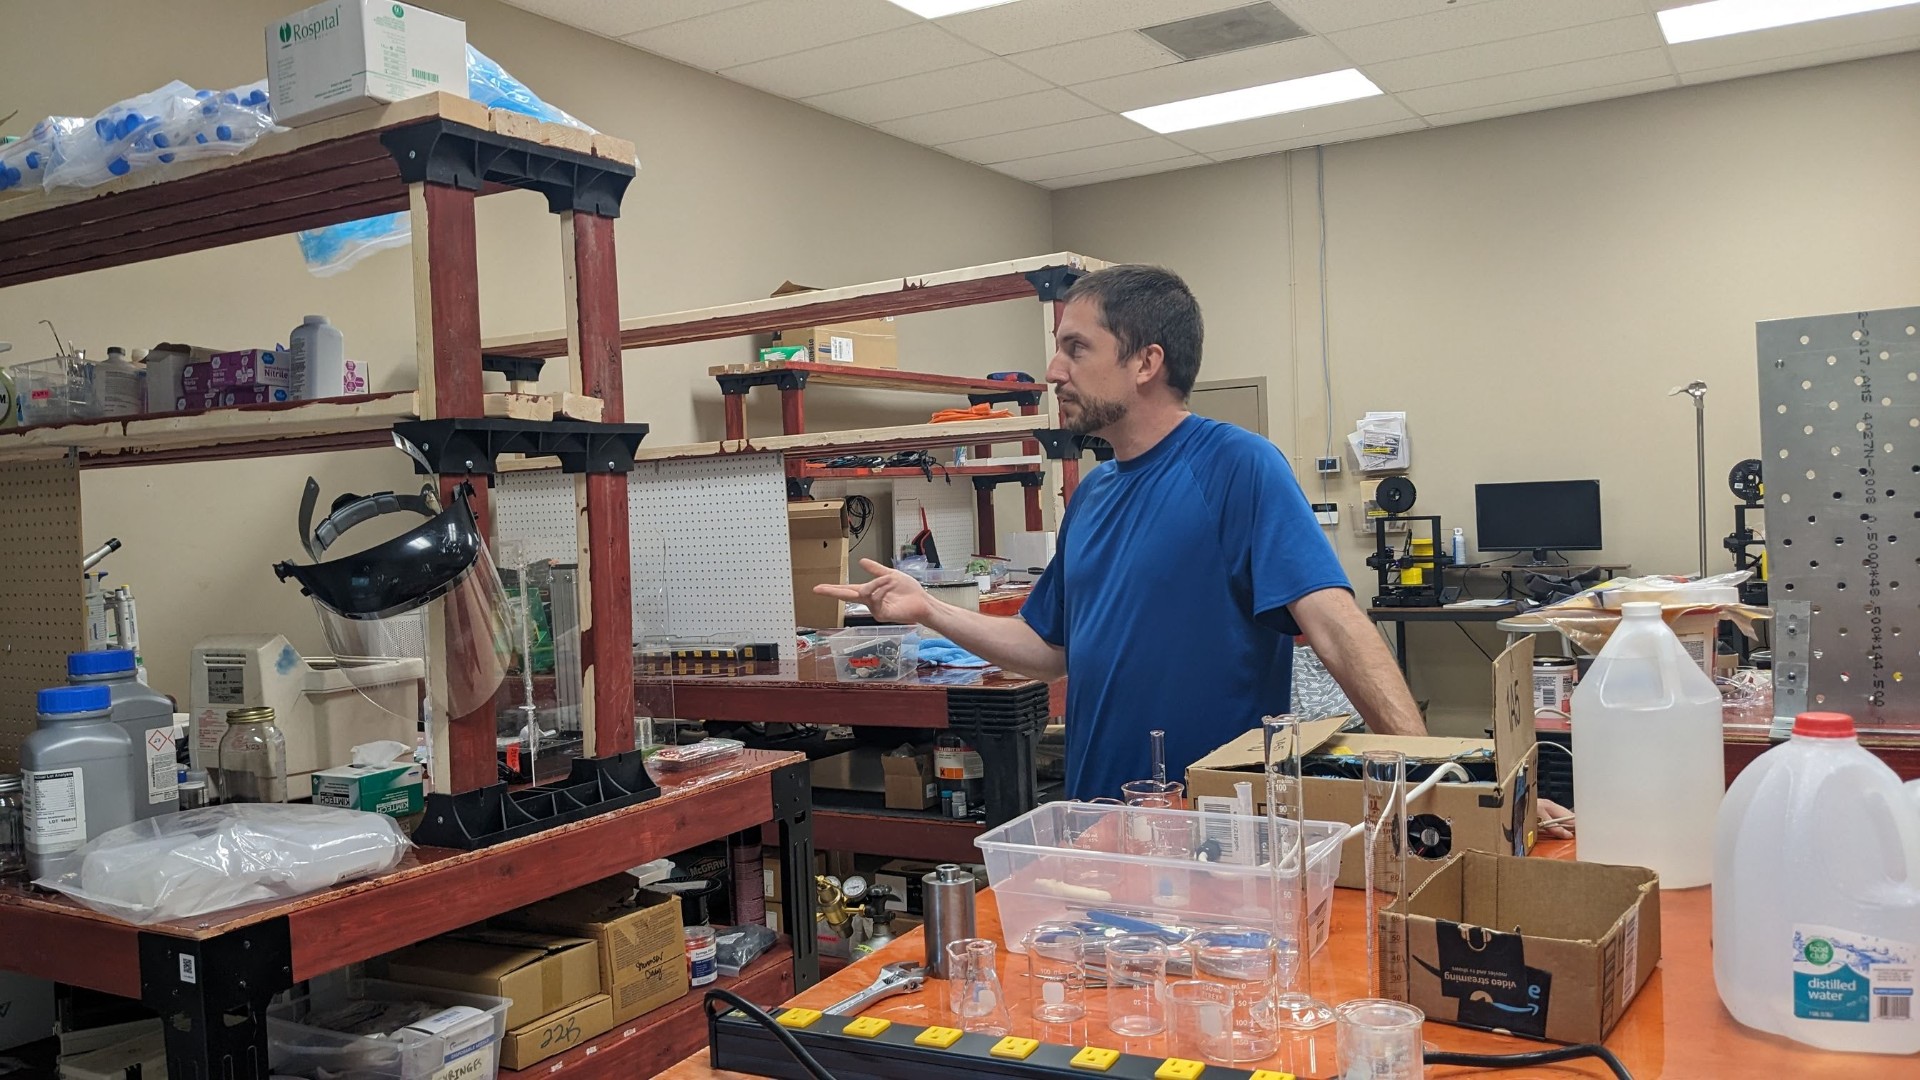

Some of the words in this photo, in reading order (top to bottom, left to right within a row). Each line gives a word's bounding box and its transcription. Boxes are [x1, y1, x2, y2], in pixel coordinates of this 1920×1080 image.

[293, 7, 340, 42] Rospital
[264, 368, 289, 380] Nitrile
[321, 796, 351, 806] KIMTECH
[376, 801, 409, 814] KIMTECH
[689, 858, 726, 877] McGRAW
[1809, 945, 1829, 953] food
[1809, 952, 1828, 960] club
[1444, 971, 1490, 985] streaming
[1807, 977, 1857, 991] distilled
[1491, 979, 1517, 990] video
[1807, 990, 1844, 1001] water
